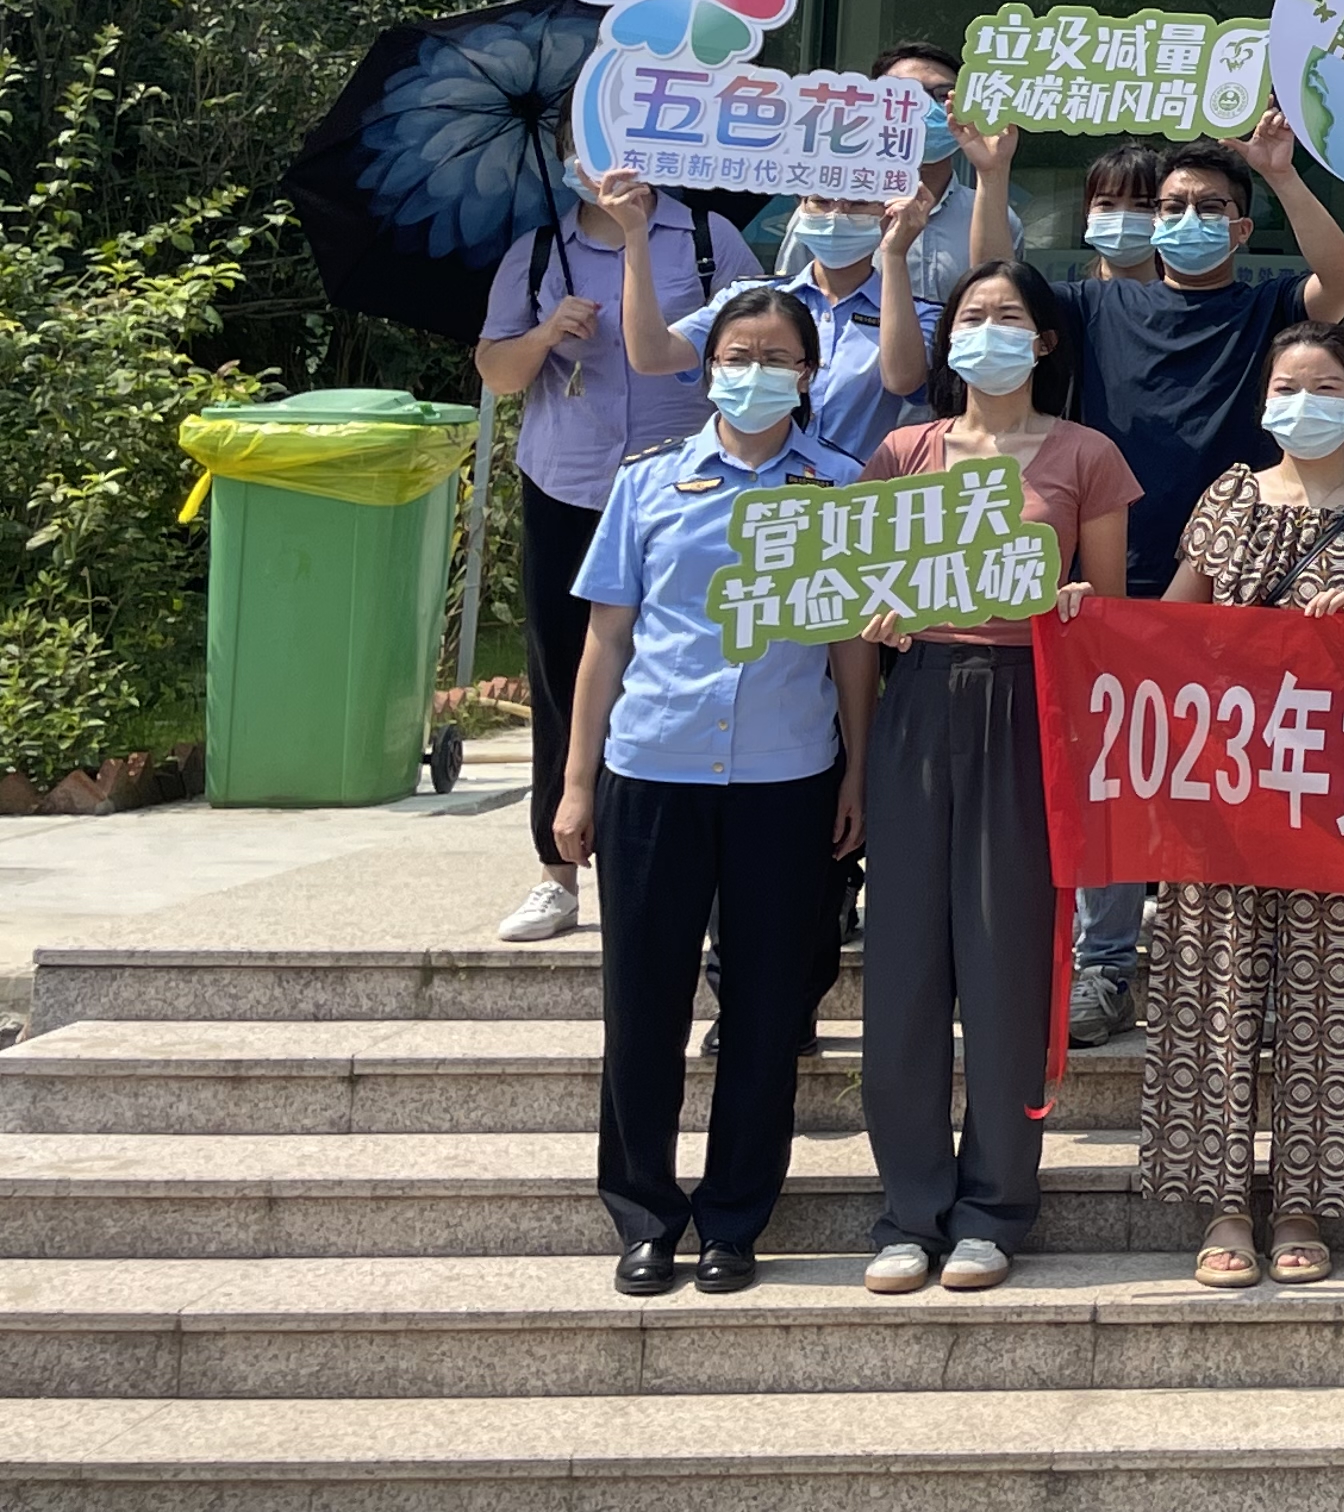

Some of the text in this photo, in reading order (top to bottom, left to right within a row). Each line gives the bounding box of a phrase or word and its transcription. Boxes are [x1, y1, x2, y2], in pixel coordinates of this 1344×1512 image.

[974, 12, 1207, 74] 垃圾减量
[626, 67, 876, 155] 五色花
[877, 88, 918, 161] 计划
[963, 71, 1200, 130] 降碳新风尚
[621, 148, 910, 193] 东莞新时代文明实践
[740, 467, 1013, 572] 管好开关
[718, 535, 1046, 650] 节俭又低碳
